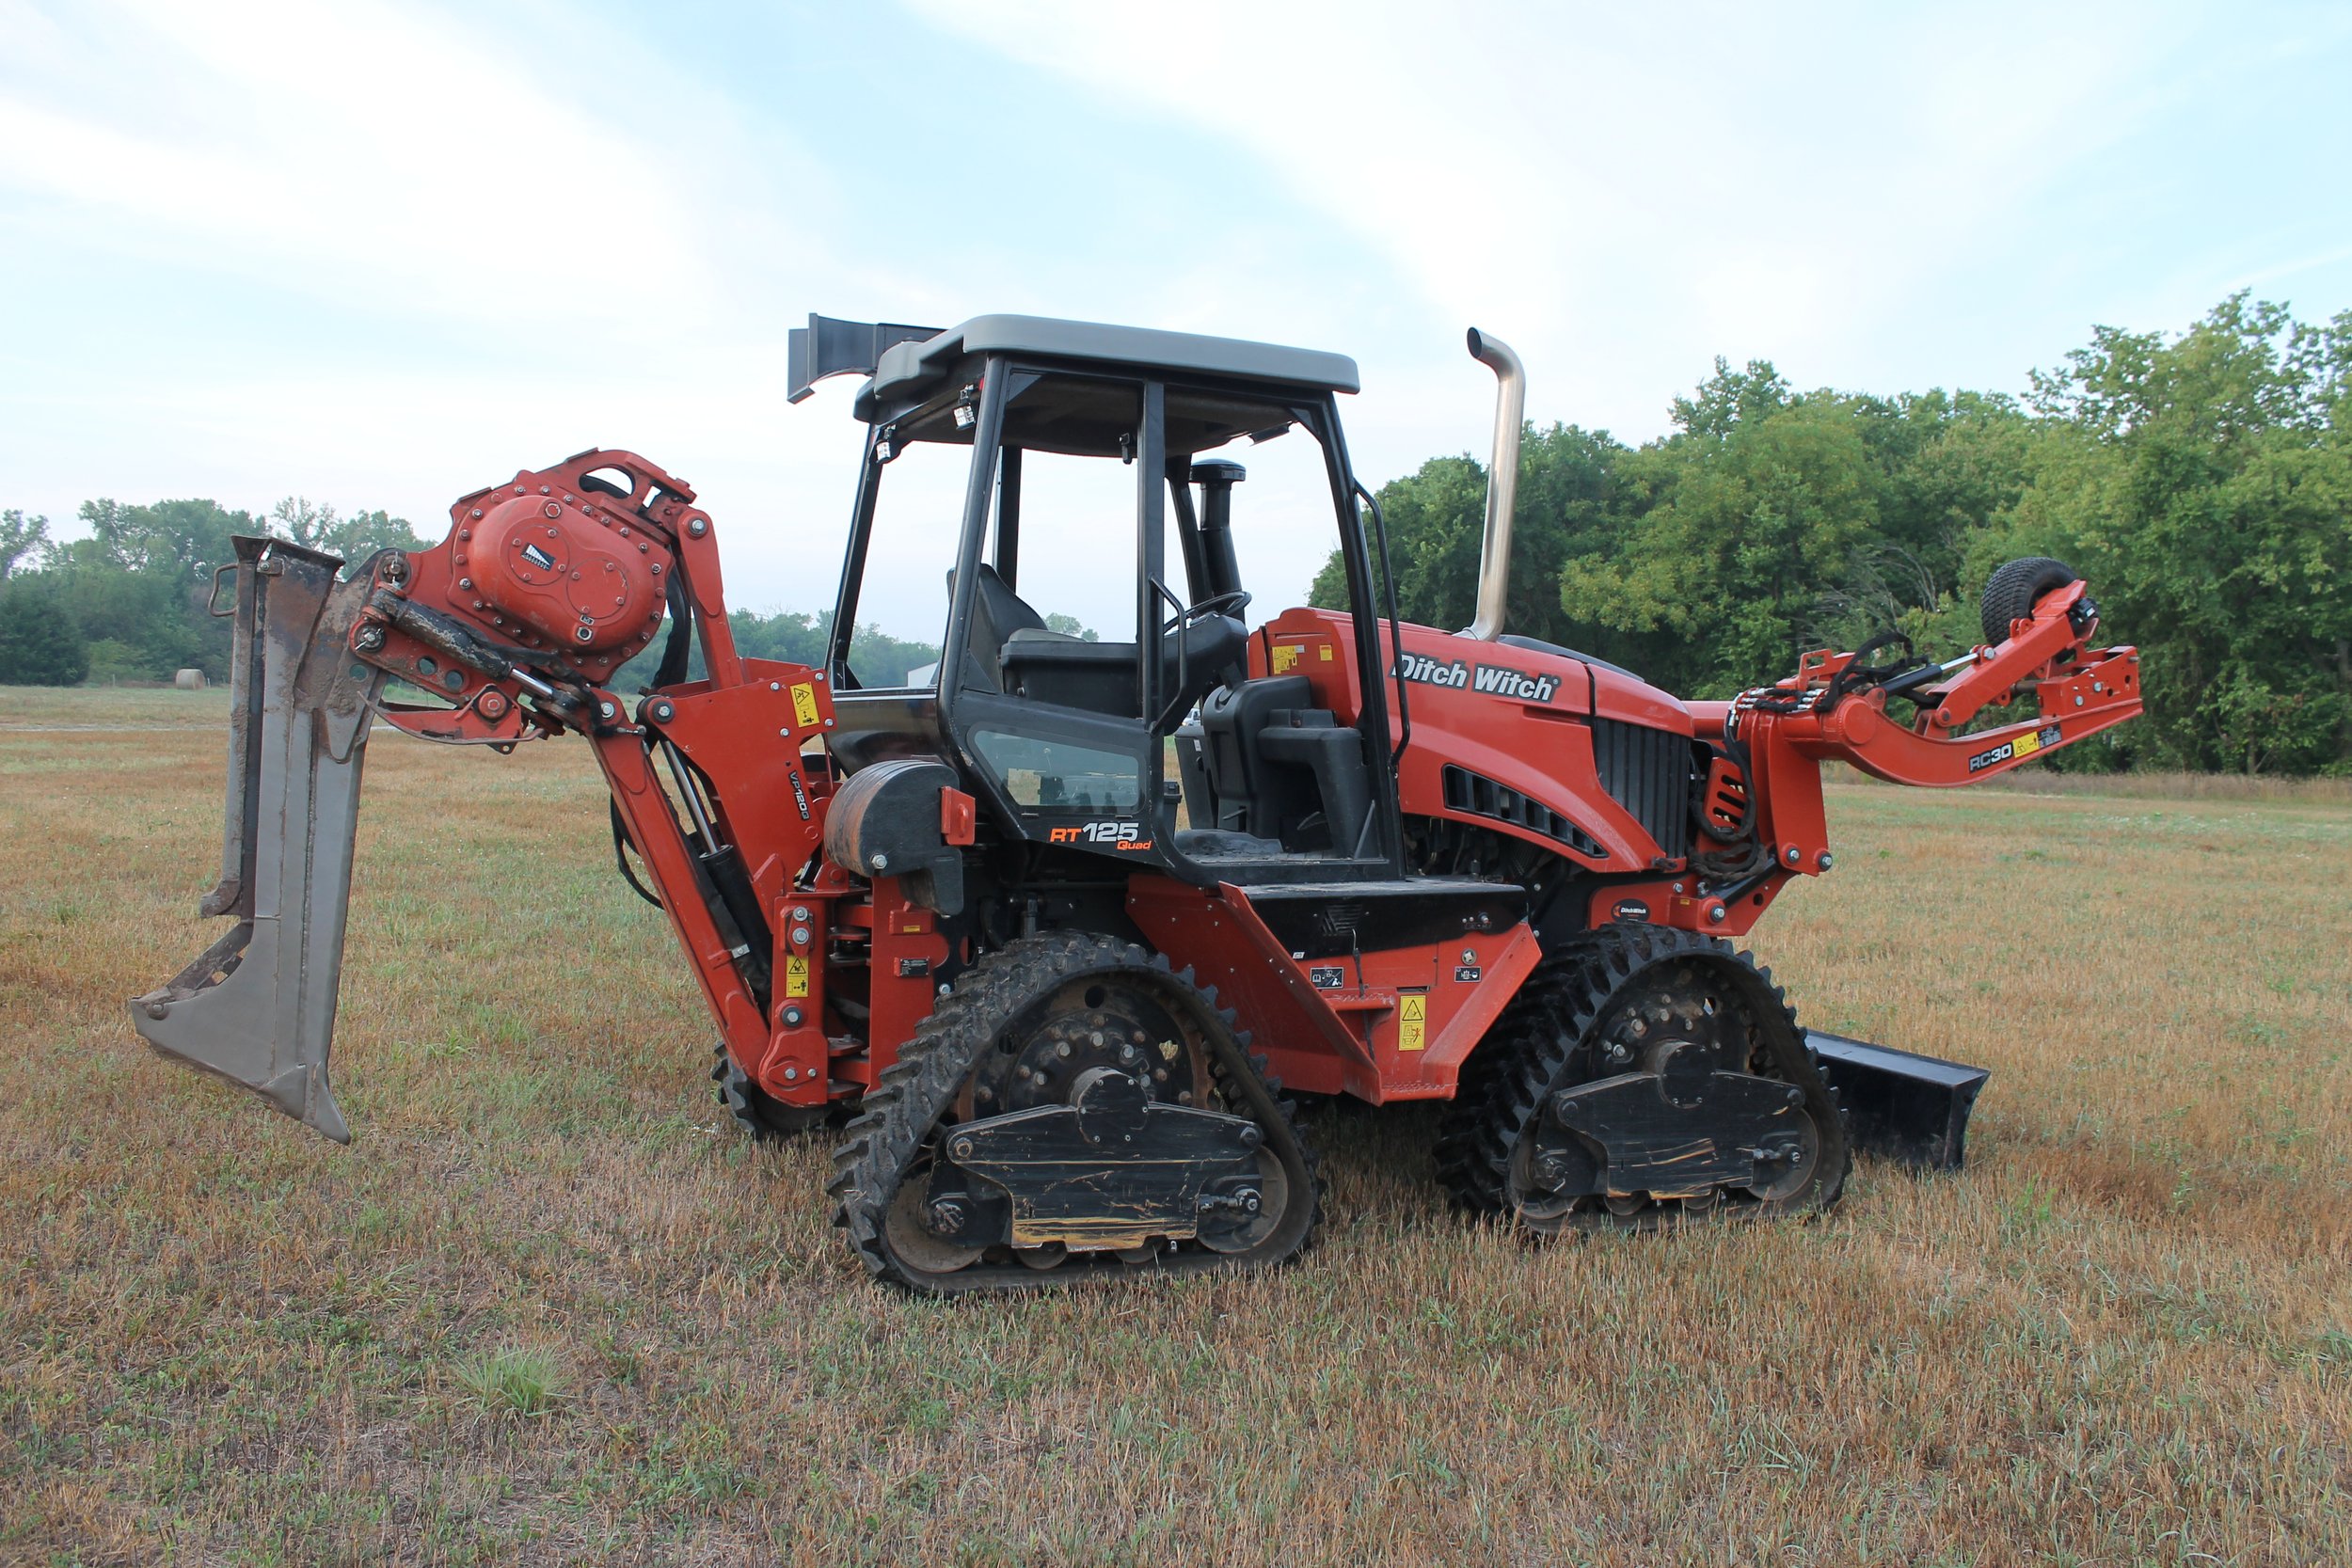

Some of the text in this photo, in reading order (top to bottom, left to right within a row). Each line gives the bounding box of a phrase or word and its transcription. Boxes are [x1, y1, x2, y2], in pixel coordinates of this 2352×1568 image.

[1391, 654, 1468, 688] Ditch
[1969, 743, 2012, 771] RC30
[1117, 840, 1152, 850] Quad
